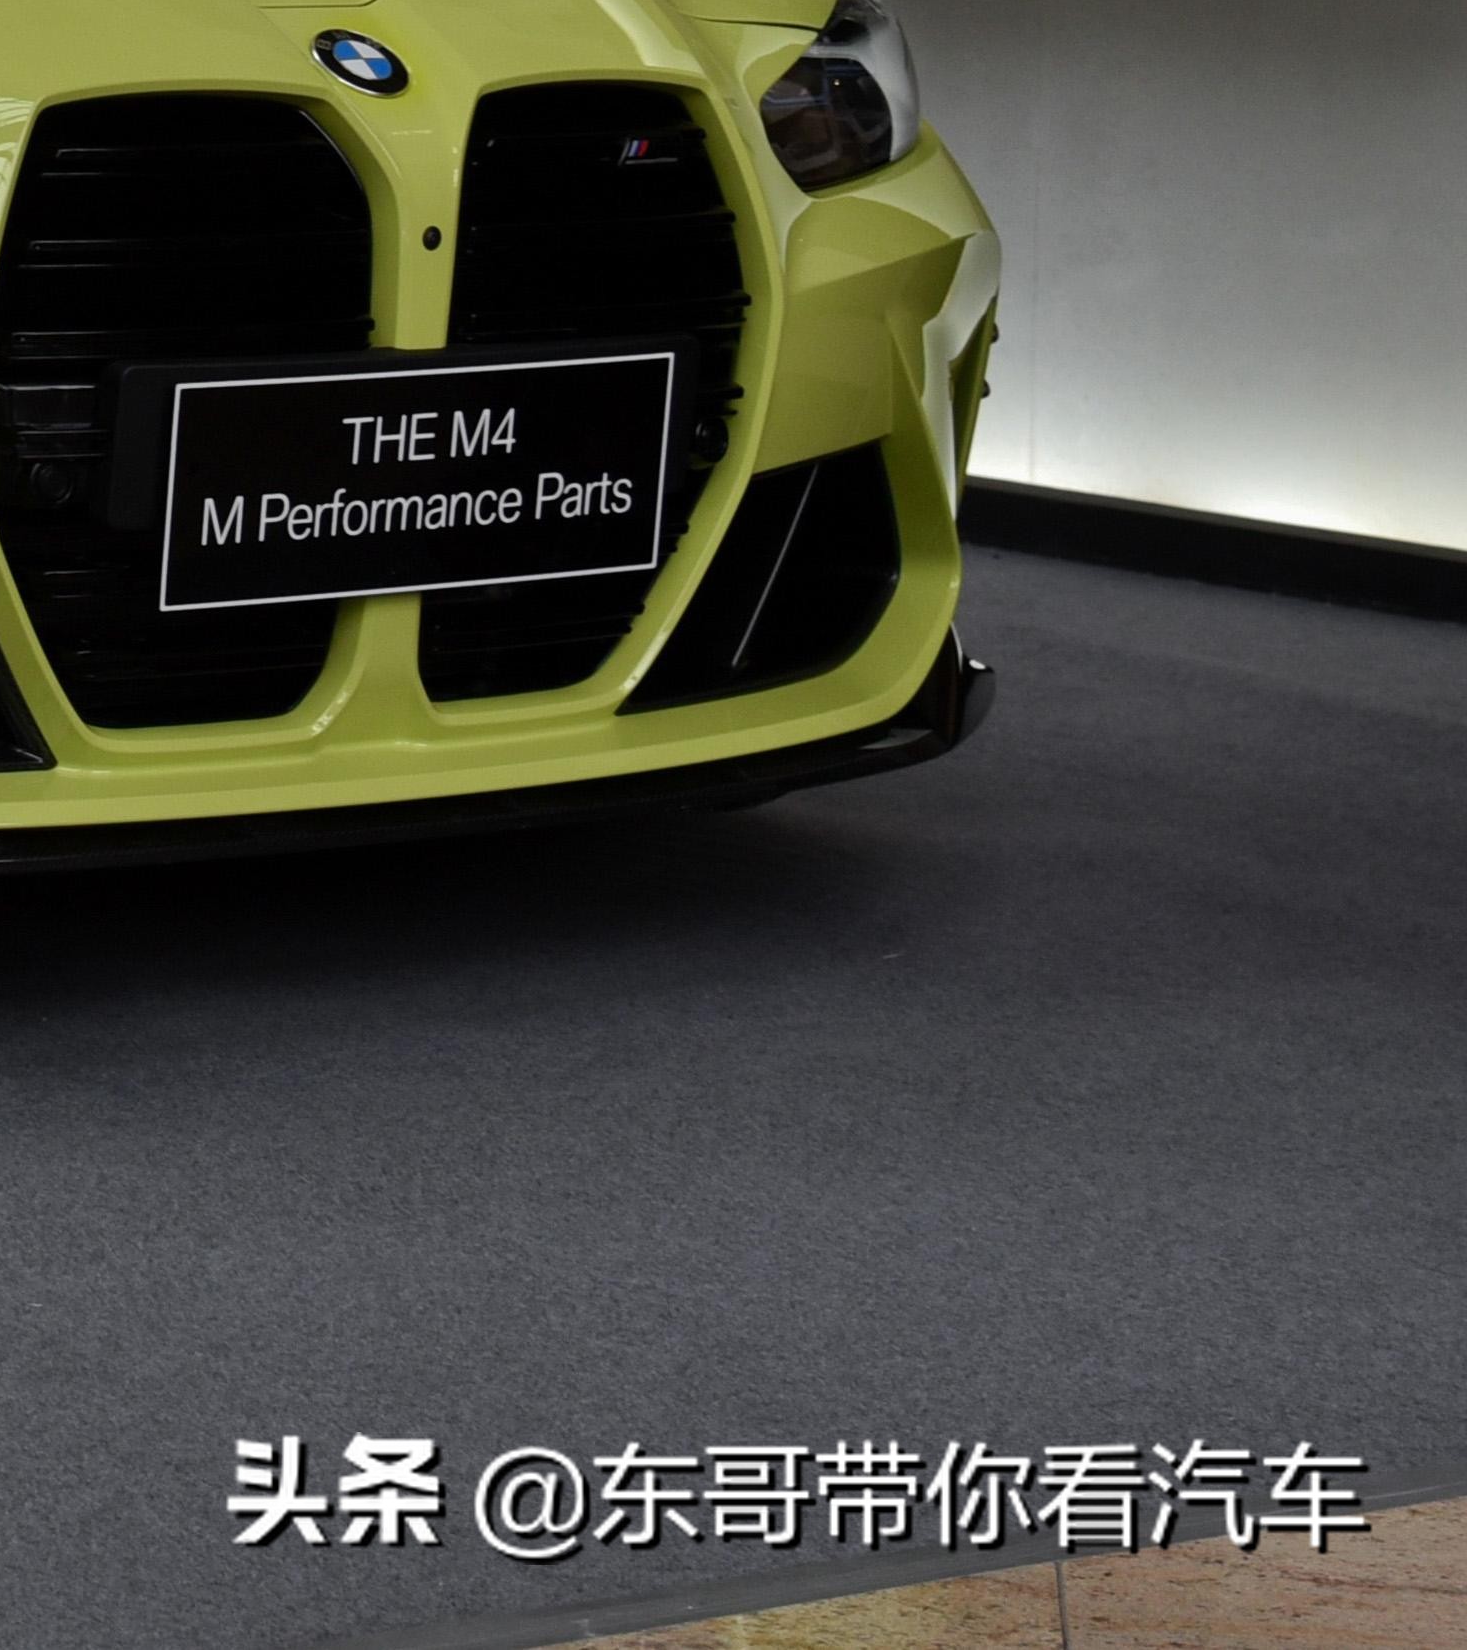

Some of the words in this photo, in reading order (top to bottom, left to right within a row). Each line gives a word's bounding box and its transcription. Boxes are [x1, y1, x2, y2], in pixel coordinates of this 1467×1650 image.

[342, 412, 438, 465] THE
[450, 408, 516, 458] M4
[201, 496, 244, 545] M
[258, 488, 522, 542] Performance
[534, 471, 633, 520] Parts
